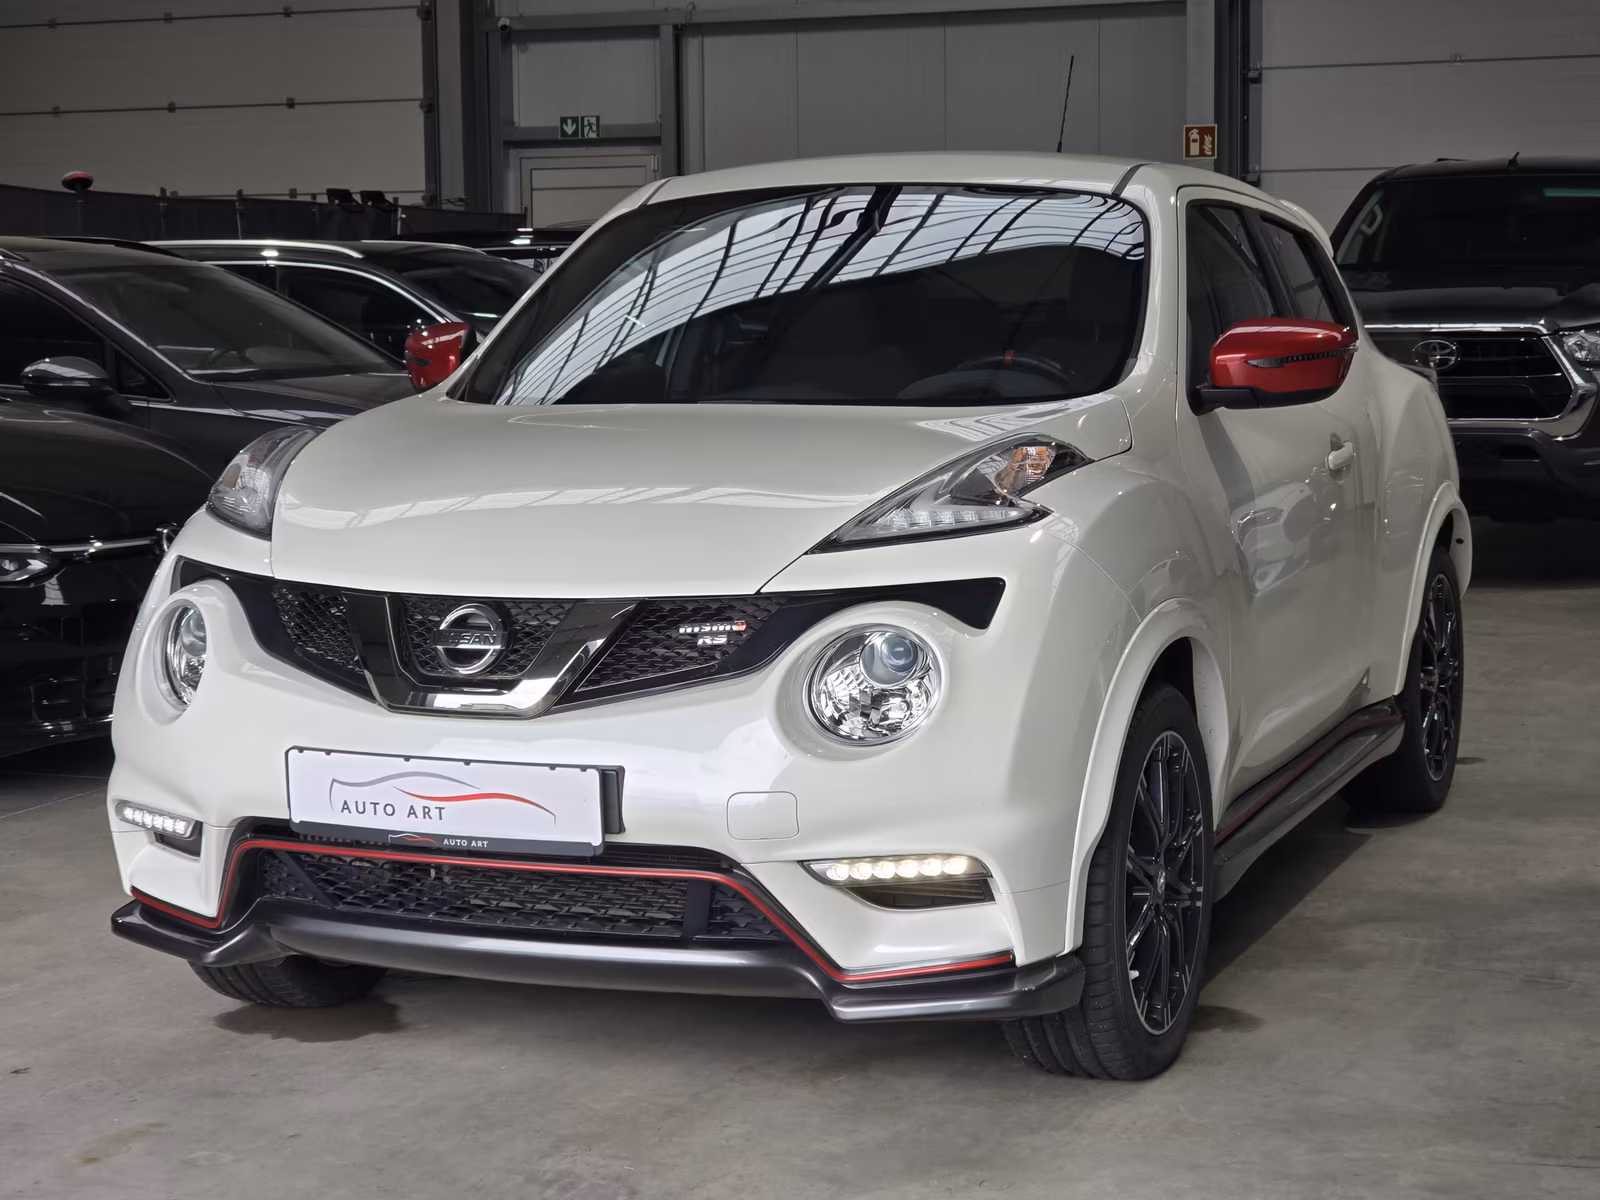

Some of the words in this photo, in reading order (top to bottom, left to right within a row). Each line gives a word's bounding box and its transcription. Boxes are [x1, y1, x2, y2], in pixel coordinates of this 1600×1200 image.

[696, 634, 728, 646] RS
[340, 799, 396, 817] AUTO
[406, 805, 446, 821] ART
[443, 838, 468, 847] AUTO
[470, 839, 489, 848] ART
